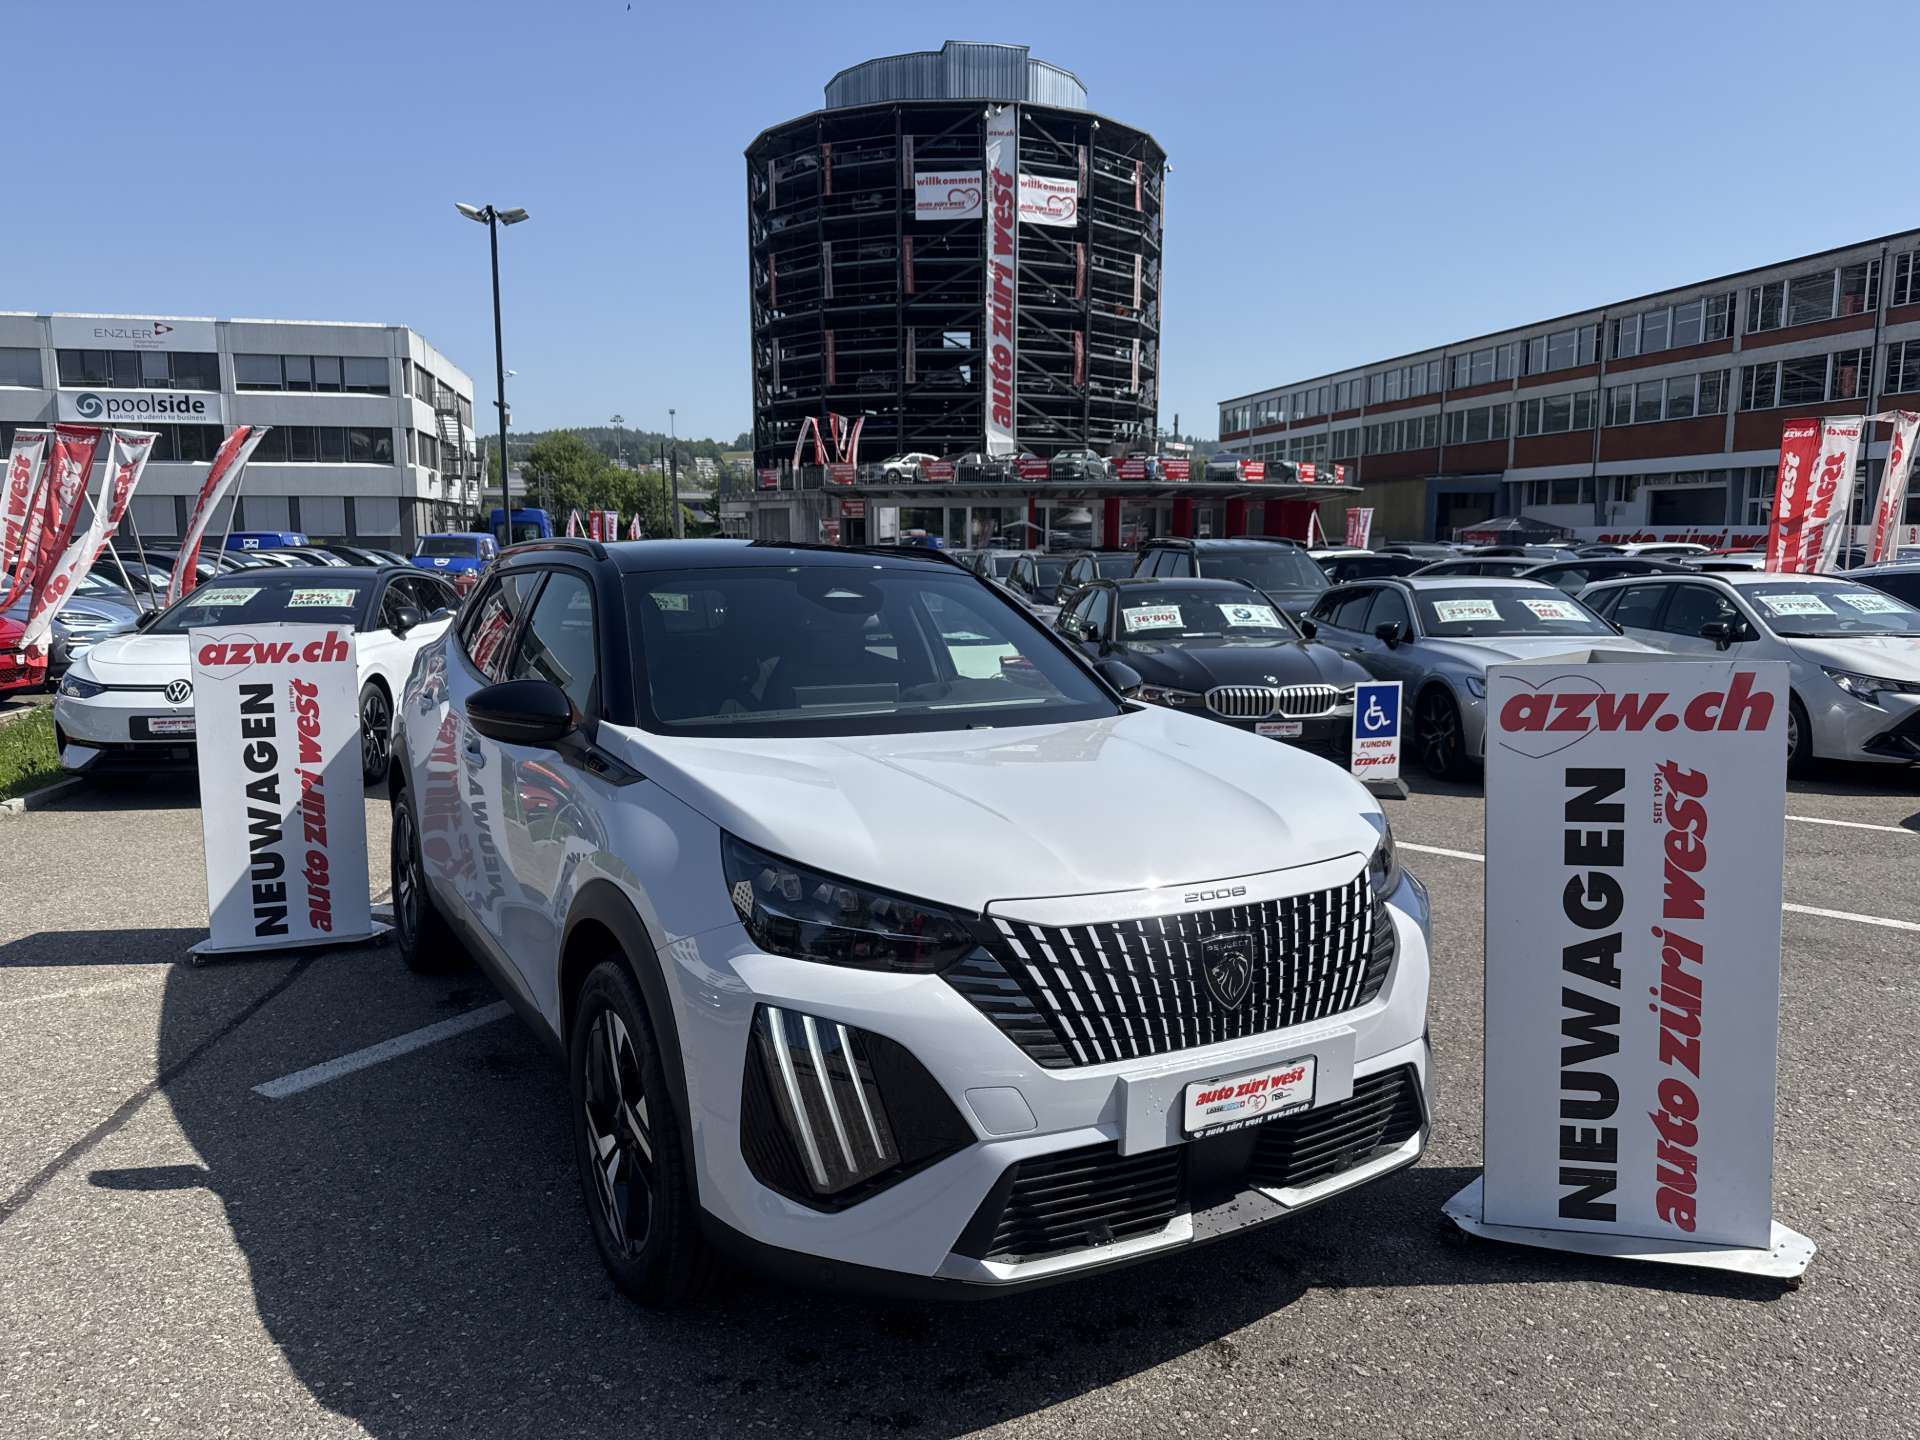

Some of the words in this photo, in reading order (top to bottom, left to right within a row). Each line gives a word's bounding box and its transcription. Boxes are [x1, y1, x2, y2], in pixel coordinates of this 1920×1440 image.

[916, 174, 981, 186] willkommen
[1020, 179, 1076, 194] willkommen
[991, 167, 1014, 256] west
[987, 258, 1013, 343] züri
[94, 328, 152, 340] ENZLER
[107, 394, 205, 419] poolside
[989, 343, 1012, 429] auto
[112, 413, 135, 421] taking
[7, 453, 32, 517] west
[1779, 451, 1800, 518] west
[1135, 614, 1176, 622] 36'800
[199, 631, 349, 666] azw.ch
[290, 677, 323, 763] west
[1500, 672, 1774, 732] azw.ch
[1354, 754, 1397, 766] azw.ch
[1360, 739, 1392, 748] KUNDEN
[239, 683, 289, 937] NEUWAGEN
[294, 767, 328, 848] züri
[1653, 772, 1663, 798] 1991
[1653, 801, 1663, 824] SEIT
[1655, 759, 1708, 919] west
[301, 849, 332, 933] auto
[1185, 886, 1246, 903] 2008
[1558, 767, 1626, 1222] NEUWAGEN
[1648, 925, 1704, 1079] züri
[1196, 1085, 1235, 1106] auto
[1235, 1075, 1271, 1097] züri
[1271, 1066, 1306, 1088] west
[1205, 1127, 1225, 1137] auto
[1245, 1116, 1264, 1128] west
[1267, 1103, 1310, 1121] www.azw.ch
[1647, 1077, 1700, 1233] auto
